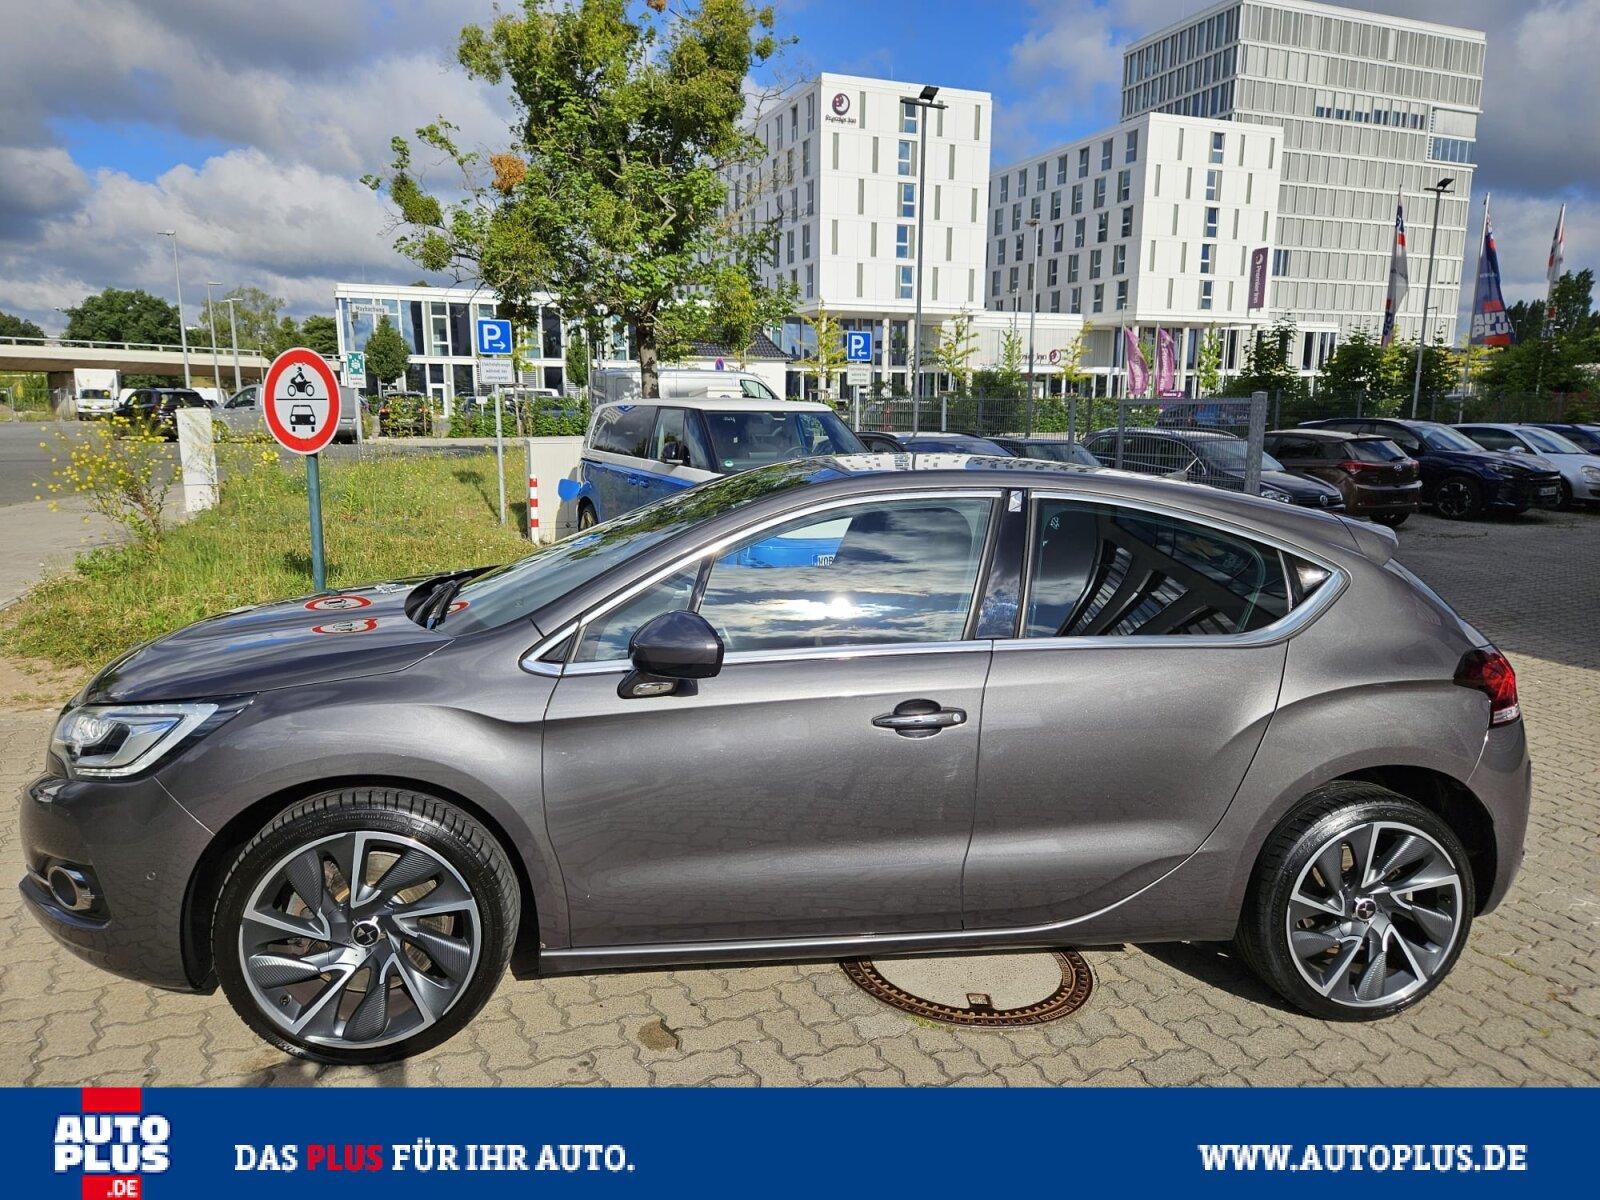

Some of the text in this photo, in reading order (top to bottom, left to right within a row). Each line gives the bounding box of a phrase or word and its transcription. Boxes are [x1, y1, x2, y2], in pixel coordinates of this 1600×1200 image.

[1254, 264, 1262, 291] Premier
[1473, 311, 1508, 326] AUT
[483, 324, 501, 349] P
[1472, 323, 1513, 338] PLU
[851, 335, 864, 356] P
